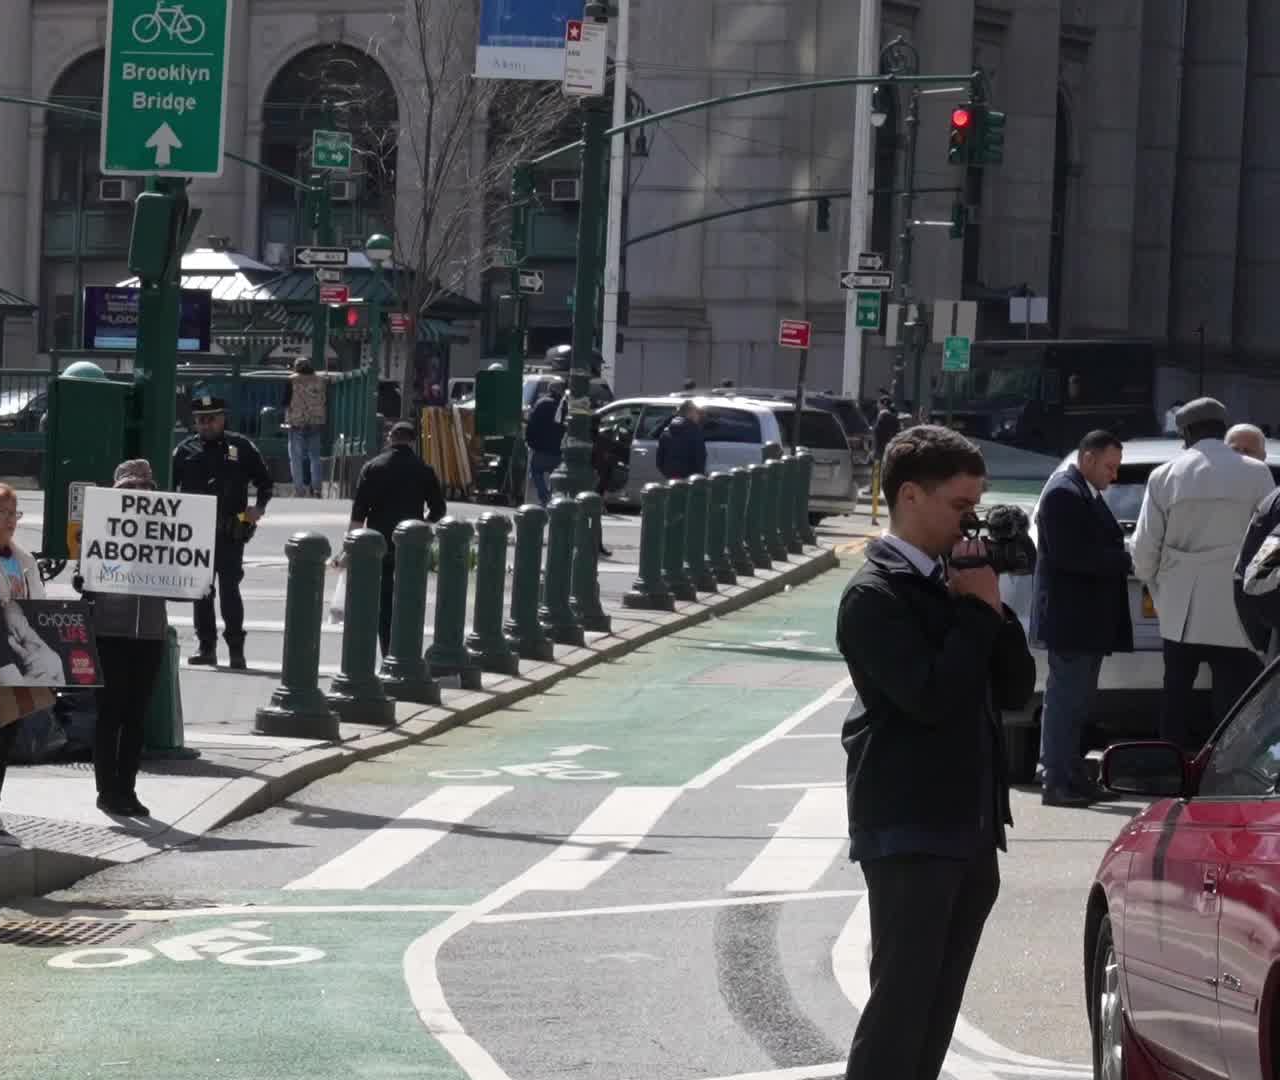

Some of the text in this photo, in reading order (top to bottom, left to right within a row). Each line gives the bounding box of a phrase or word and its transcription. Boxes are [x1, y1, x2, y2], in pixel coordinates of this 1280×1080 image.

[122, 63, 210, 85] Brooklyn
[132, 92, 197, 116] Bridge
[121, 495, 182, 517] PRAY
[107, 517, 193, 542] TO END
[86, 540, 211, 568] ABORTION
[38, 613, 85, 627] CHOOSE
